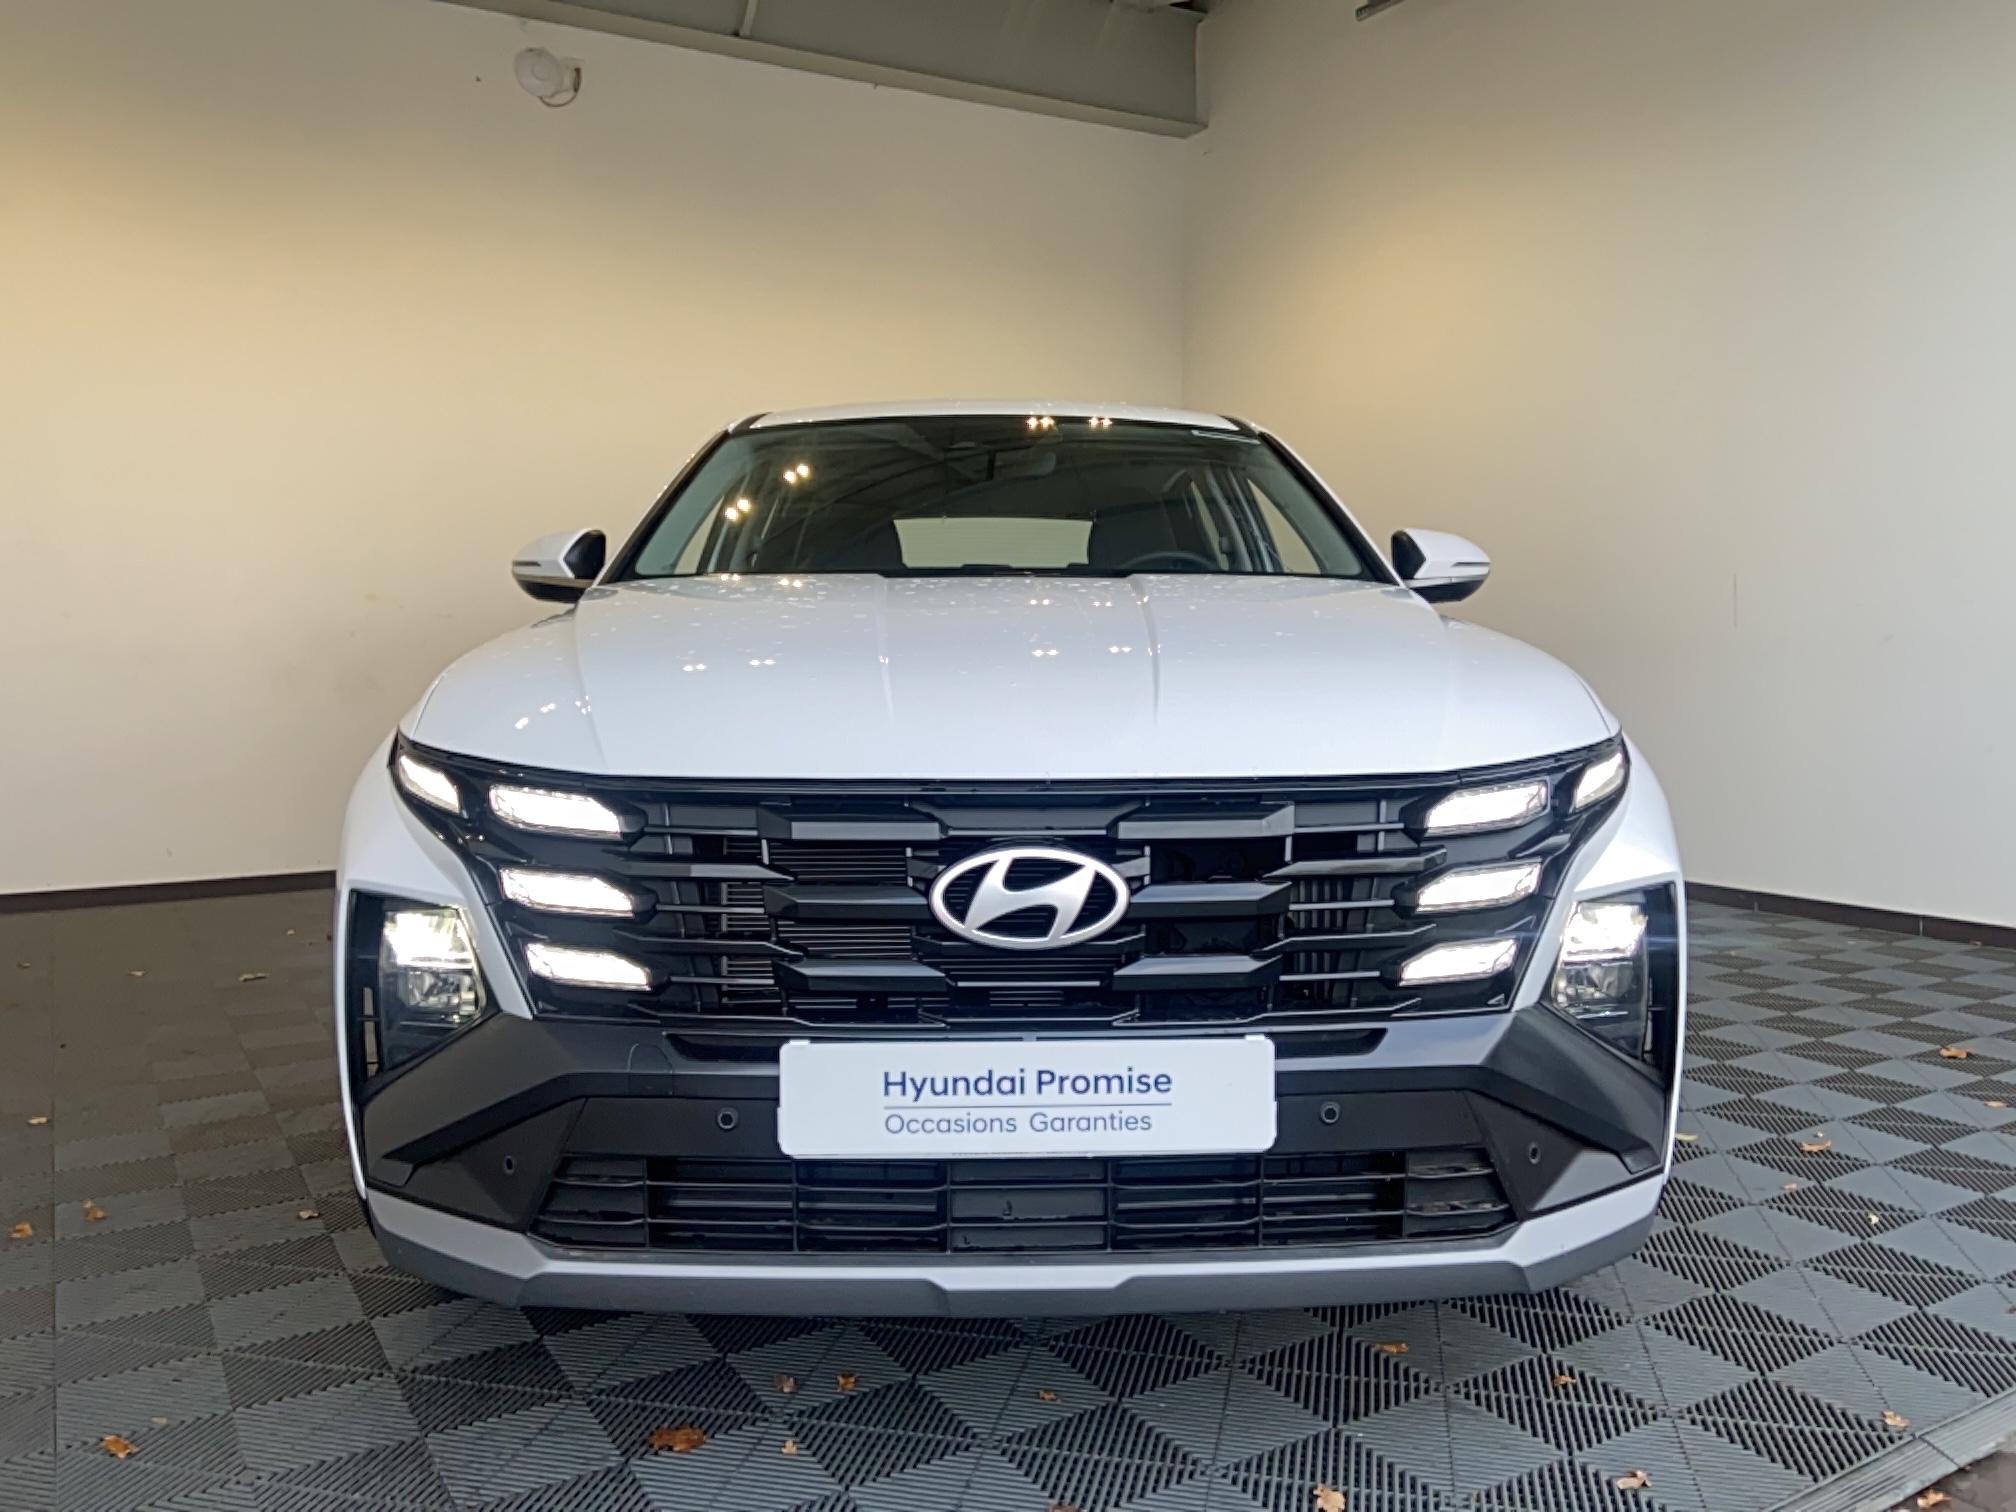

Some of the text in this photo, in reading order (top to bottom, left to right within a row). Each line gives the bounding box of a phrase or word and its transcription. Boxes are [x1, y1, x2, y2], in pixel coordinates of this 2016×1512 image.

[883, 1066, 1172, 1102] Hyundai Promise
[884, 1110, 1153, 1134] Occasions Garanties
